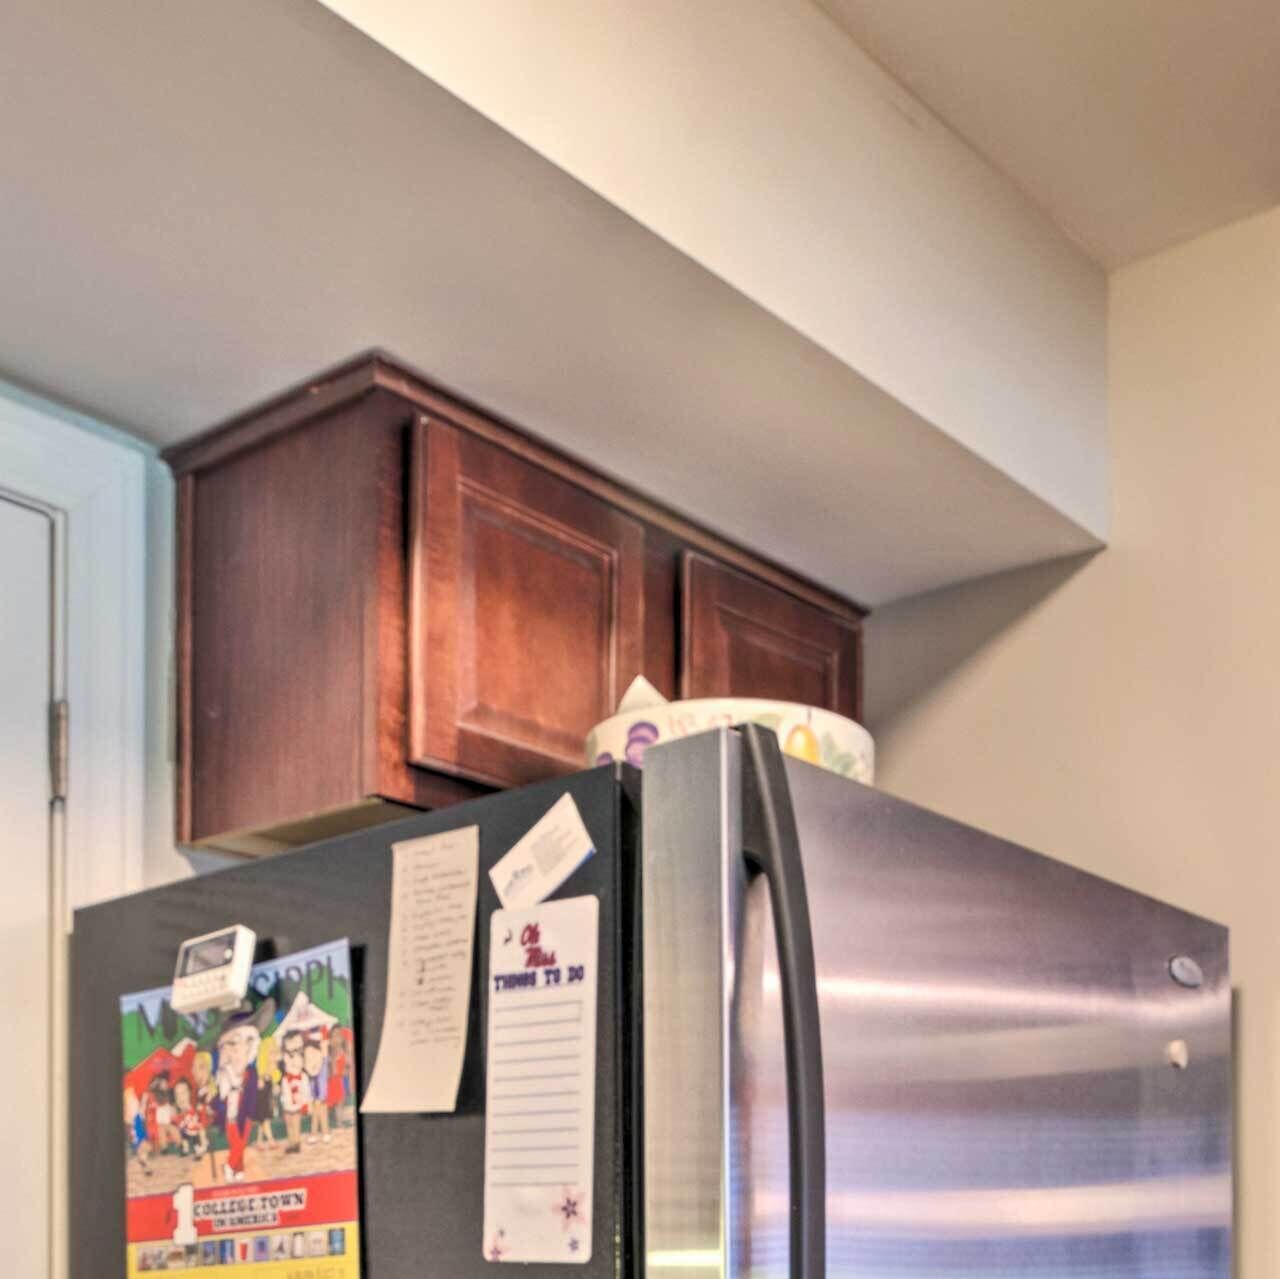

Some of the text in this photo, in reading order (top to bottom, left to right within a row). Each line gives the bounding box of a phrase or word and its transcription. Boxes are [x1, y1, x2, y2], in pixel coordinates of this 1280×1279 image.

[494, 965, 584, 991] THINGS TO DO
[193, 1198, 255, 1218] COLLEGE
[261, 1191, 305, 1210] TOWN
